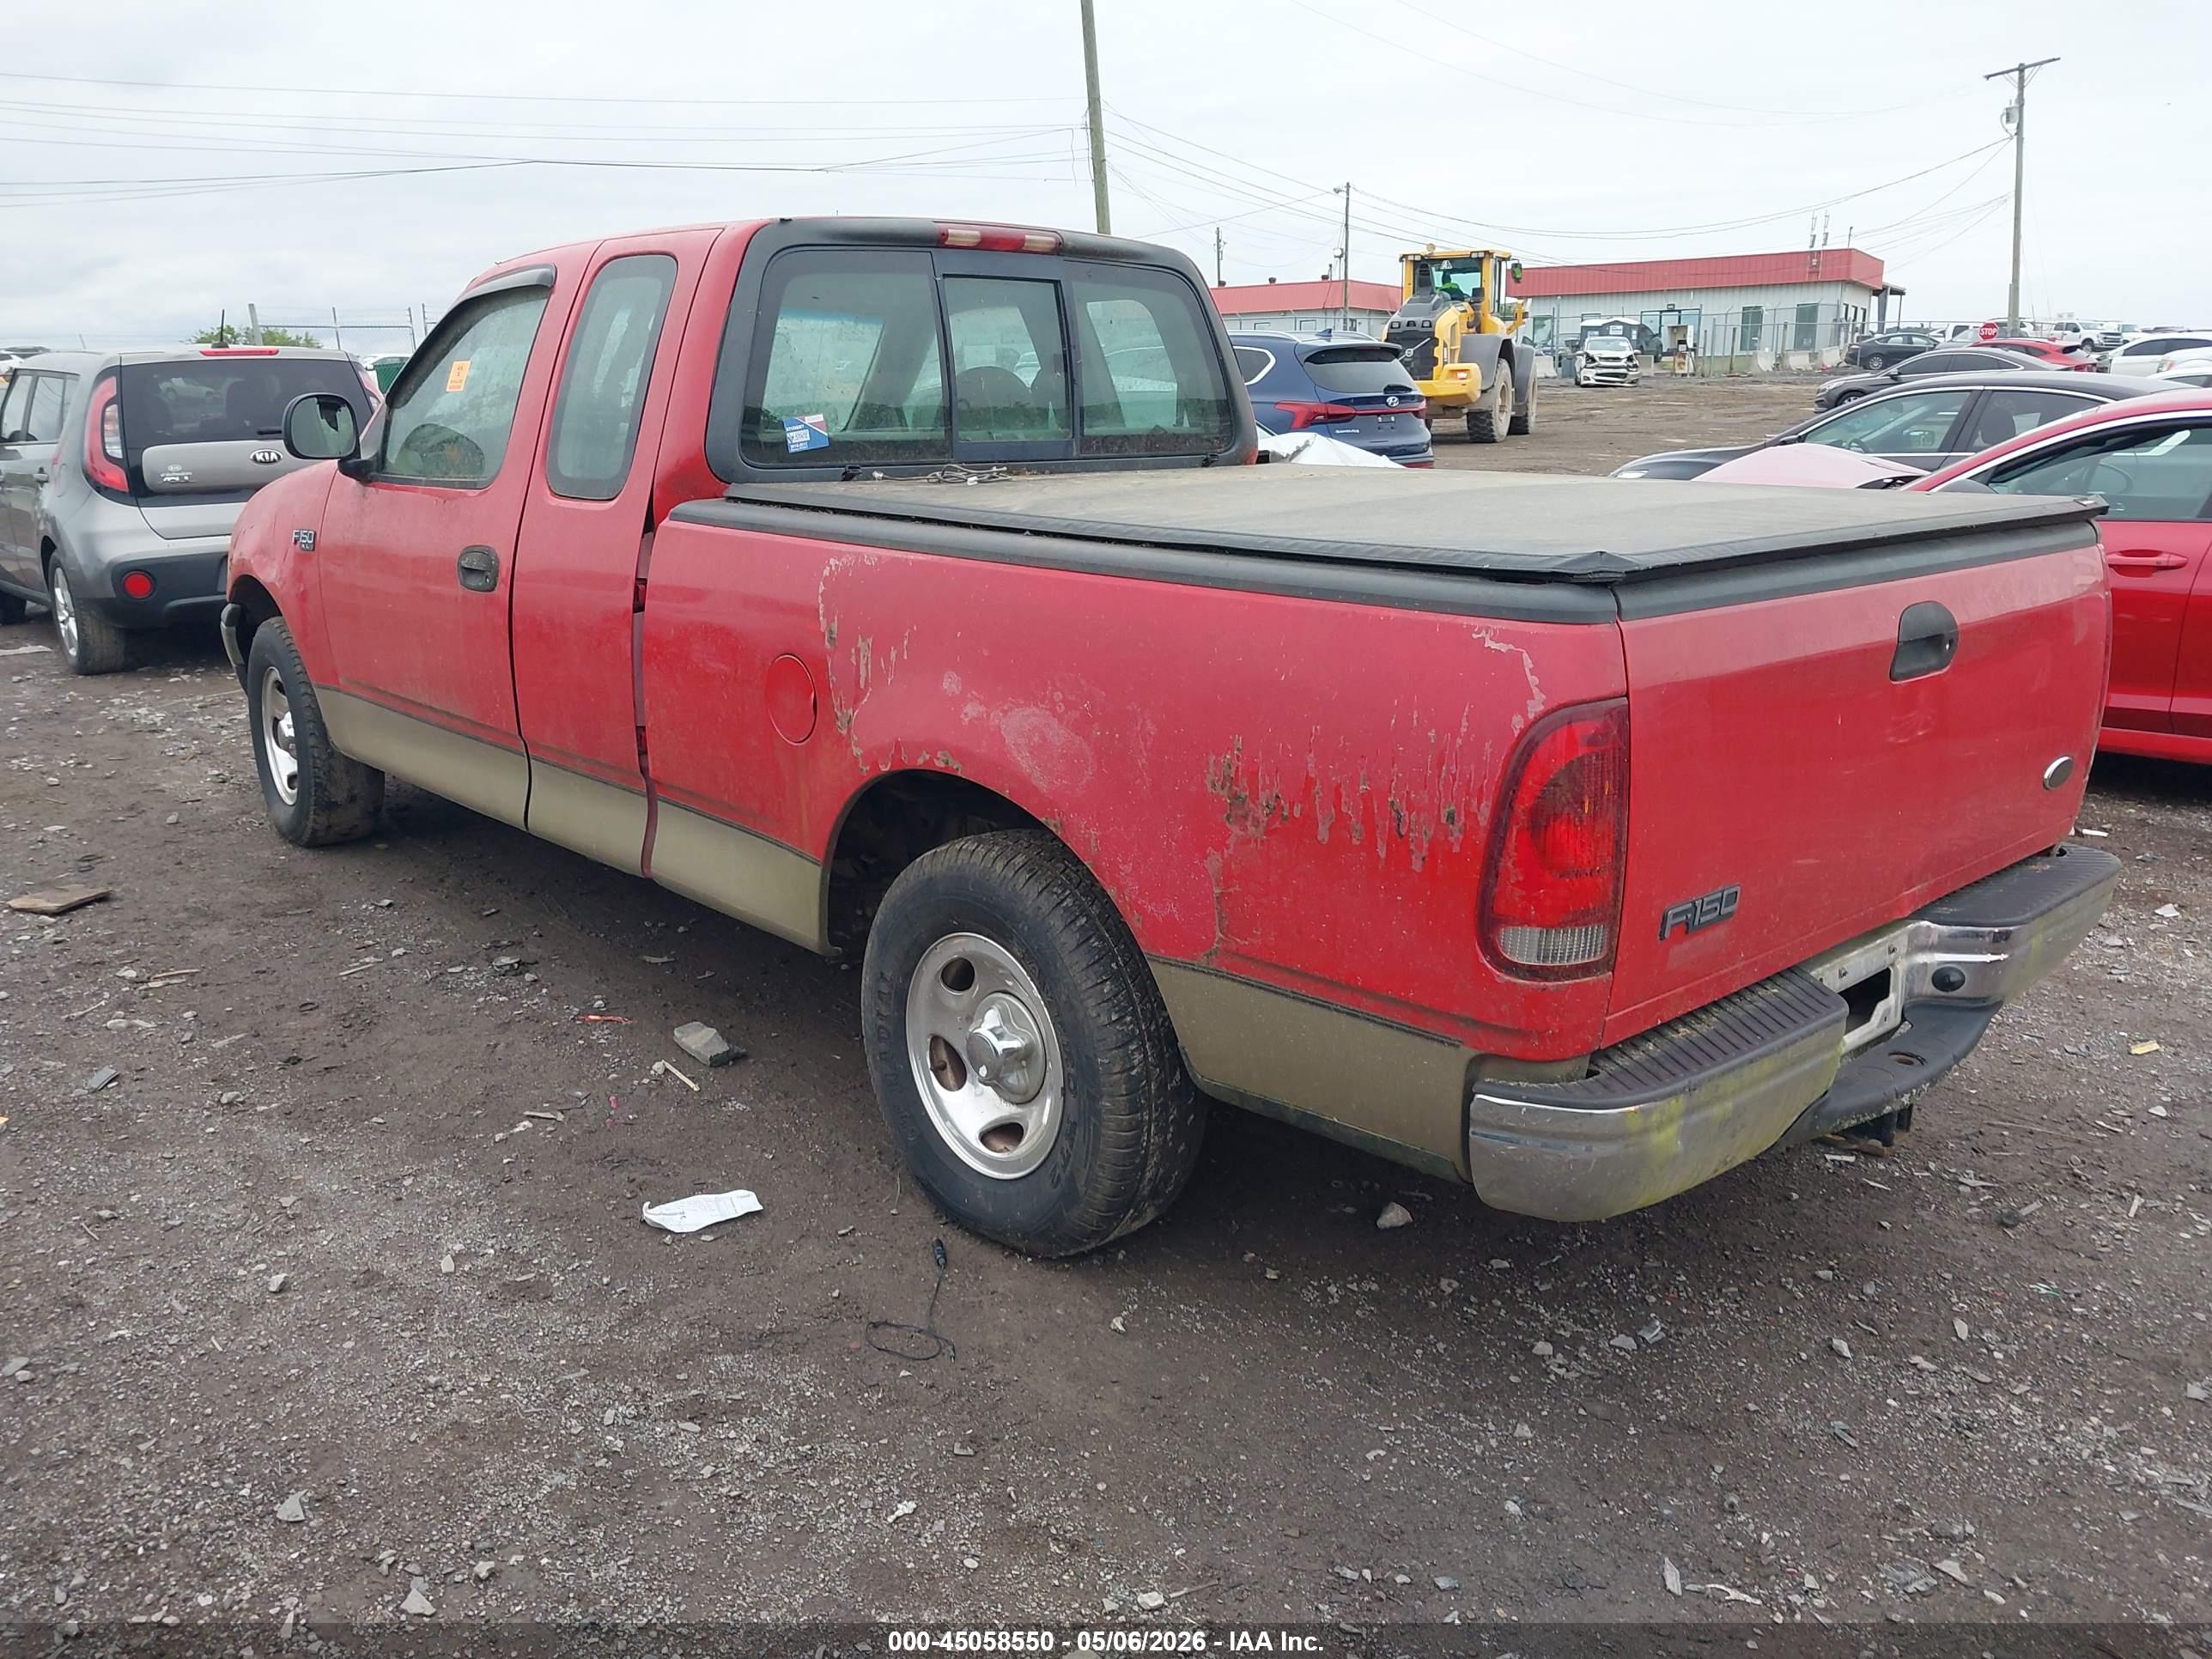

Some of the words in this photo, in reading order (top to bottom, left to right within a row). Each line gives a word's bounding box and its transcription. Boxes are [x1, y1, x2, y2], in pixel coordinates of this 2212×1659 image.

[1980, 327, 1997, 336] STOP
[255, 451, 278, 462] KIA
[1659, 884, 1741, 941] F150
